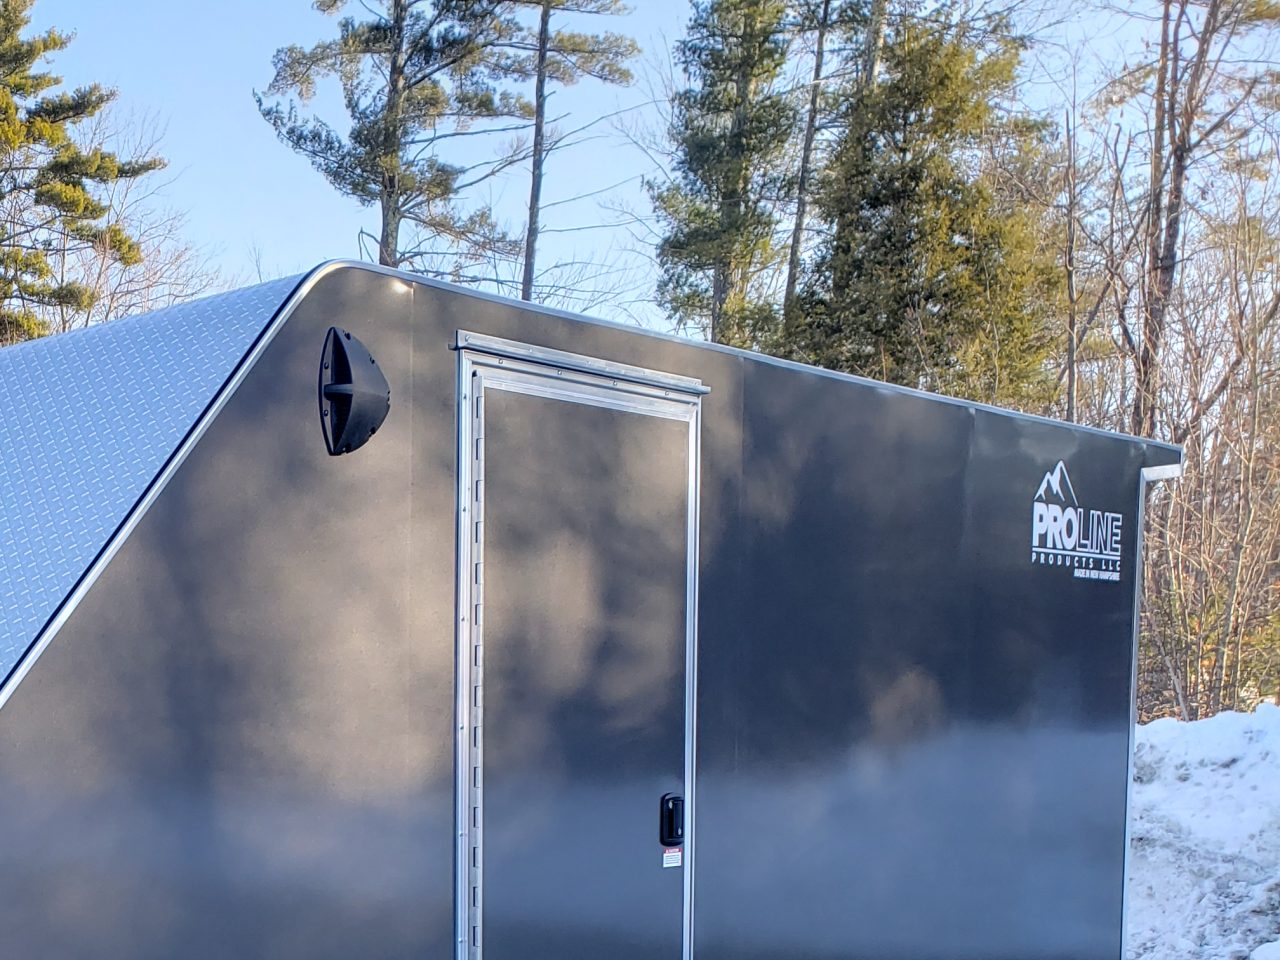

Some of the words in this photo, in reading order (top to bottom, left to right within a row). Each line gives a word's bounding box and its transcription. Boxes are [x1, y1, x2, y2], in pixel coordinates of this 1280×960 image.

[1032, 502, 1122, 555] PROLINE
[1032, 553, 1094, 568] PRODUCTS
[1101, 559, 1121, 571] LLC
